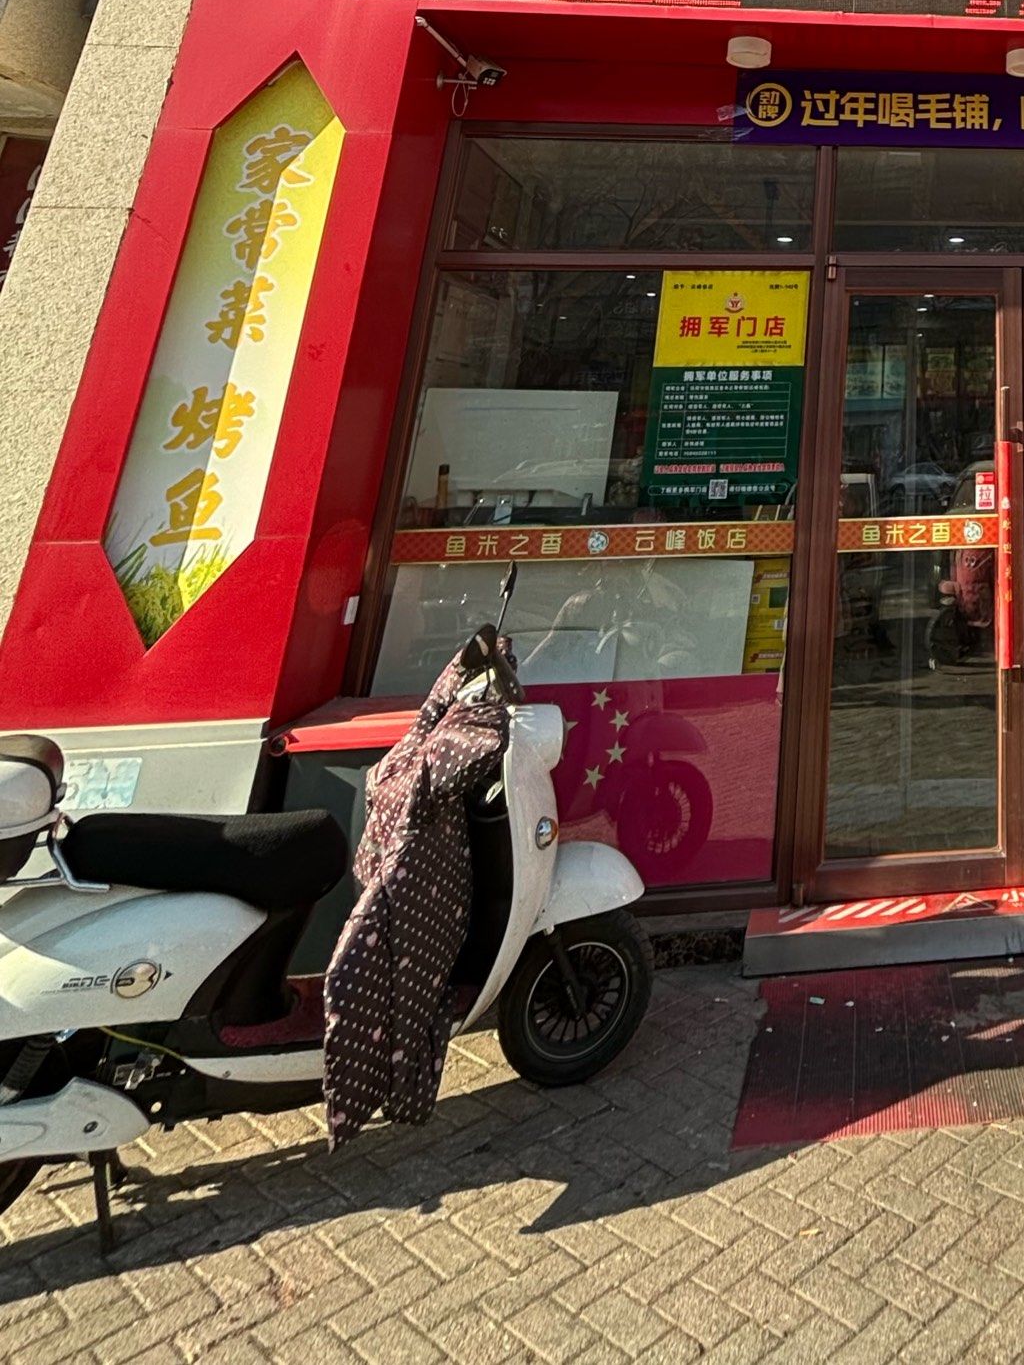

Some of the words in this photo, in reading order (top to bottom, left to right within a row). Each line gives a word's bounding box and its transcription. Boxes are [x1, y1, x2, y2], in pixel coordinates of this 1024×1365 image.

[205, 124, 315, 346] 家常菜
[679, 316, 786, 338] 拥军门店
[149, 383, 256, 545] 烤鱼
[979, 485, 991, 501] 拉
[444, 535, 562, 557] 鱼米之香
[634, 528, 748, 552] 云峰饭店
[861, 522, 951, 546] 鱼米之香
